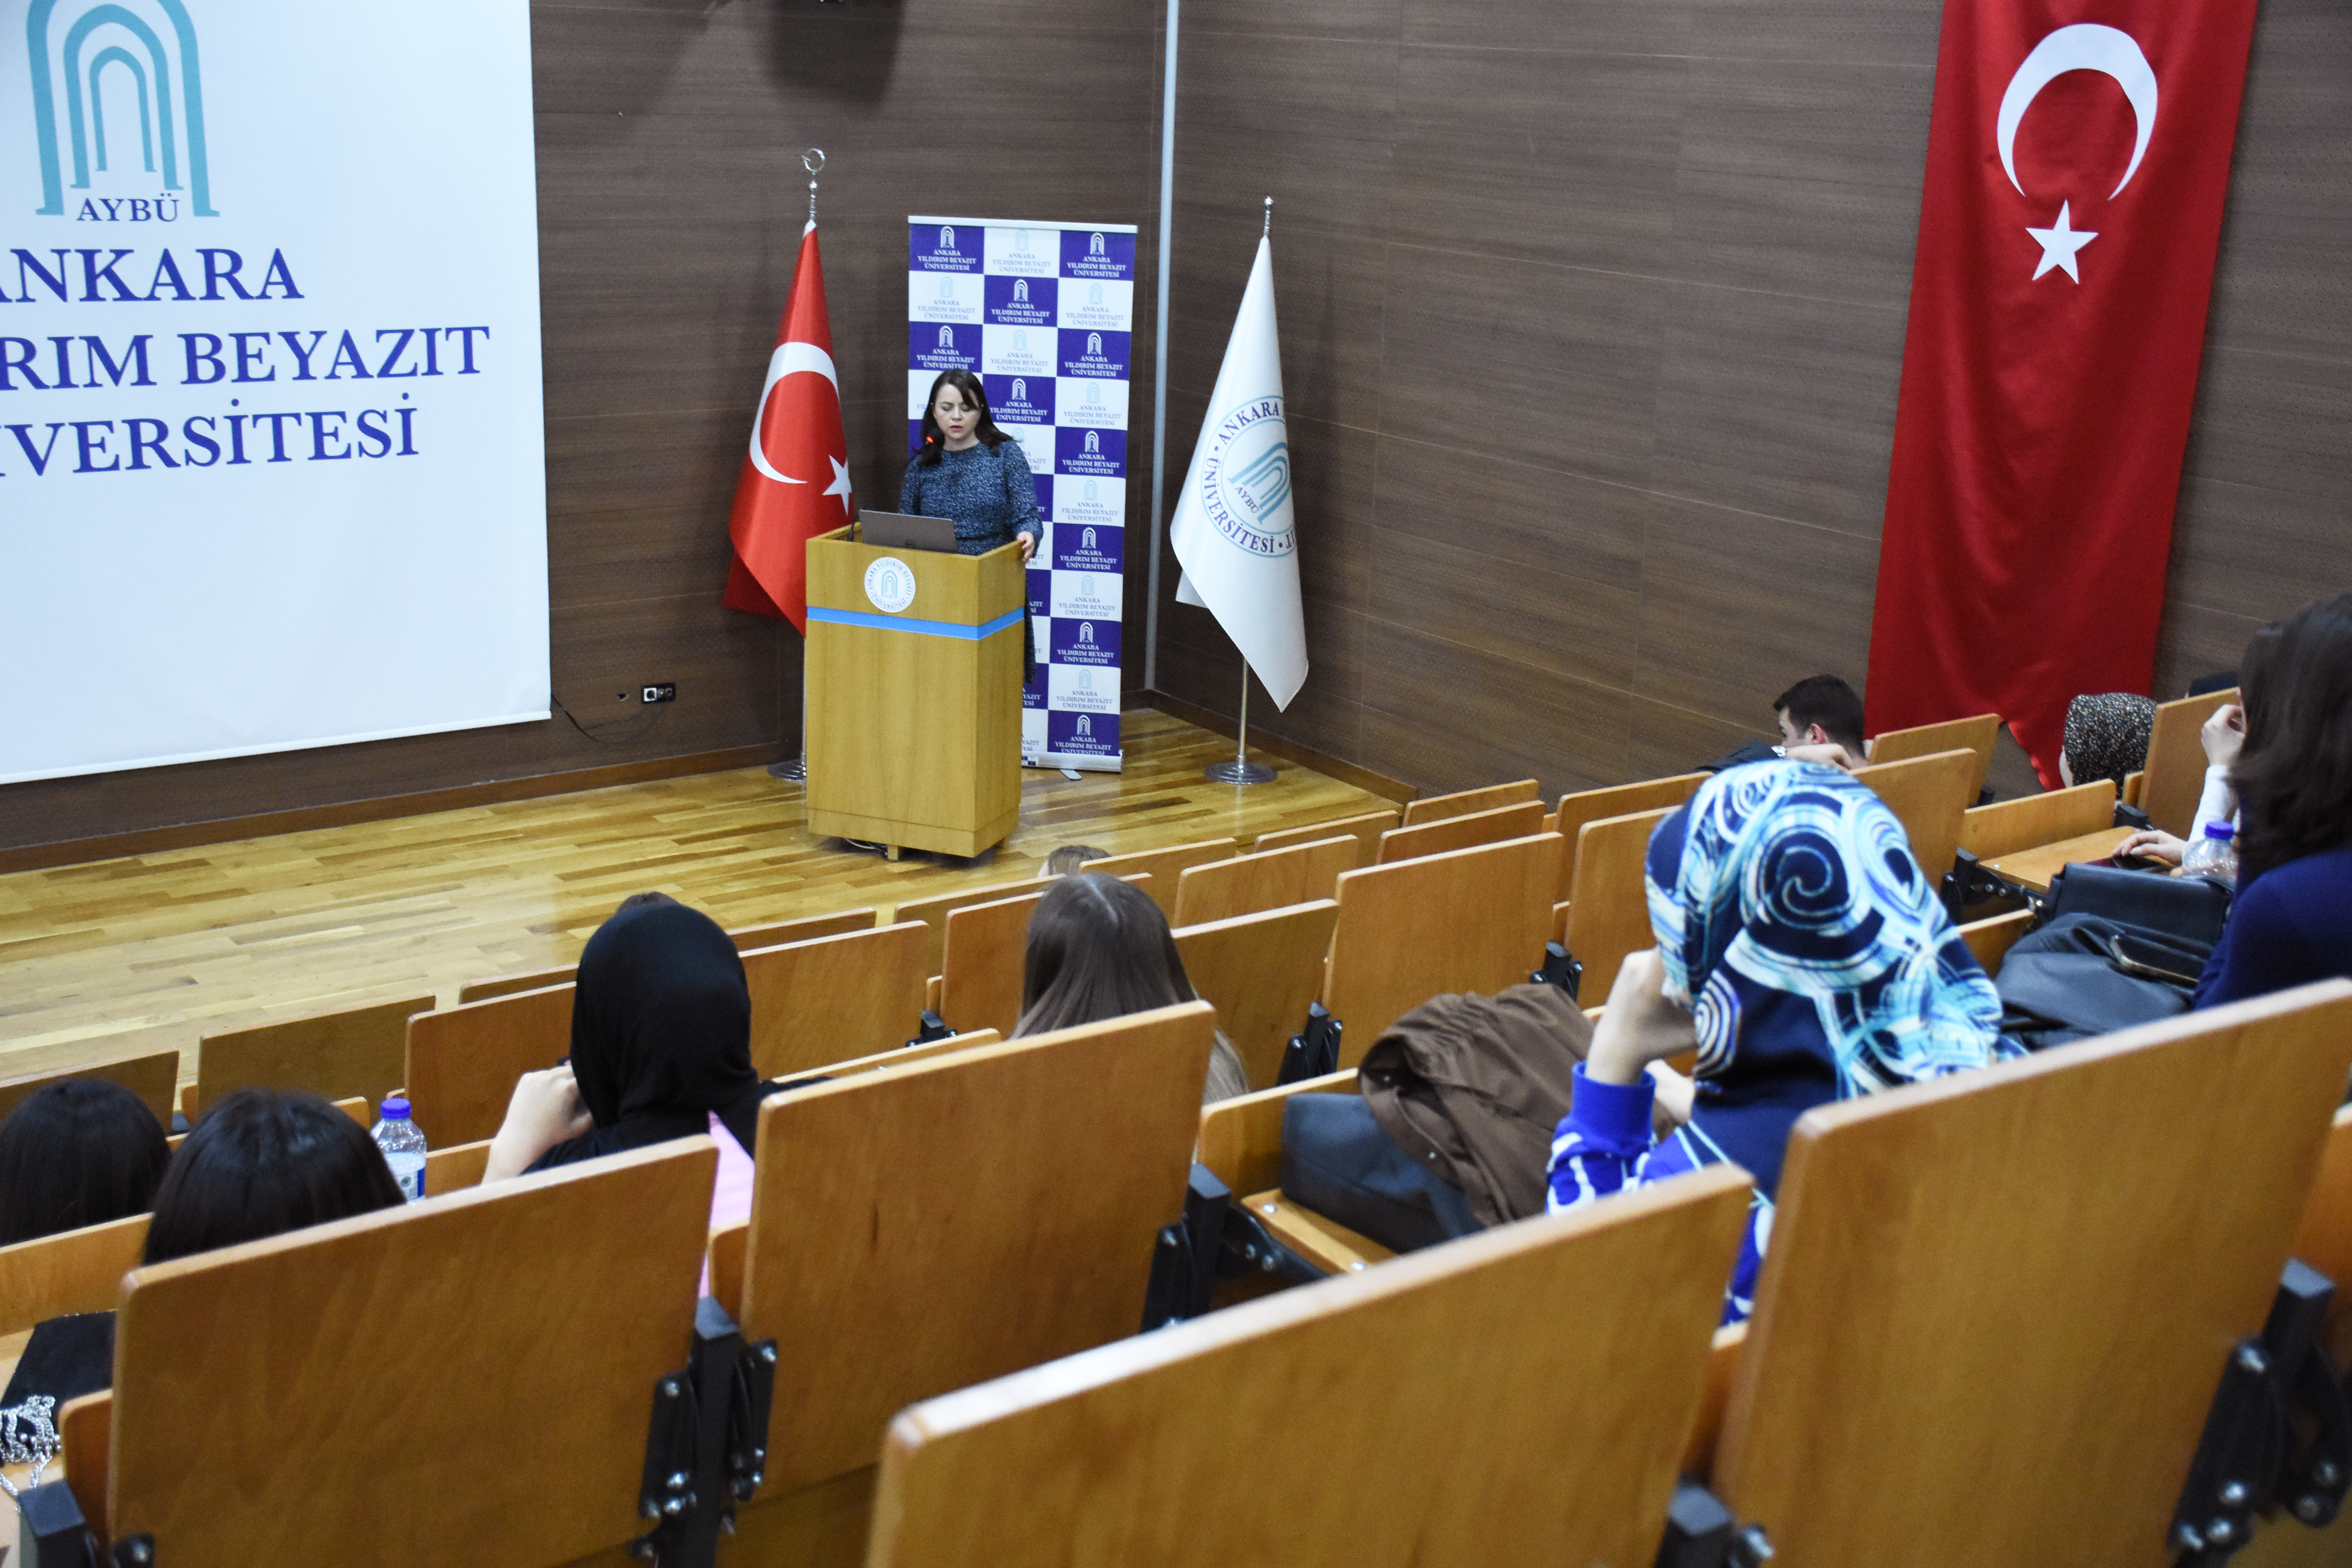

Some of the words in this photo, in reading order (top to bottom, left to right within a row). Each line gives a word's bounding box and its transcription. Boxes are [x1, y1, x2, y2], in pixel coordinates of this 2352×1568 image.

[76, 193, 179, 222] AYBÜ
[0, 248, 305, 303] NKARA
[177, 326, 490, 385] BEYAZIT
[0, 392, 419, 476] VERSİTESİ
[1218, 401, 1279, 445] ANKARA
[1204, 457, 1275, 553] ÜNİVERSİTESİ
